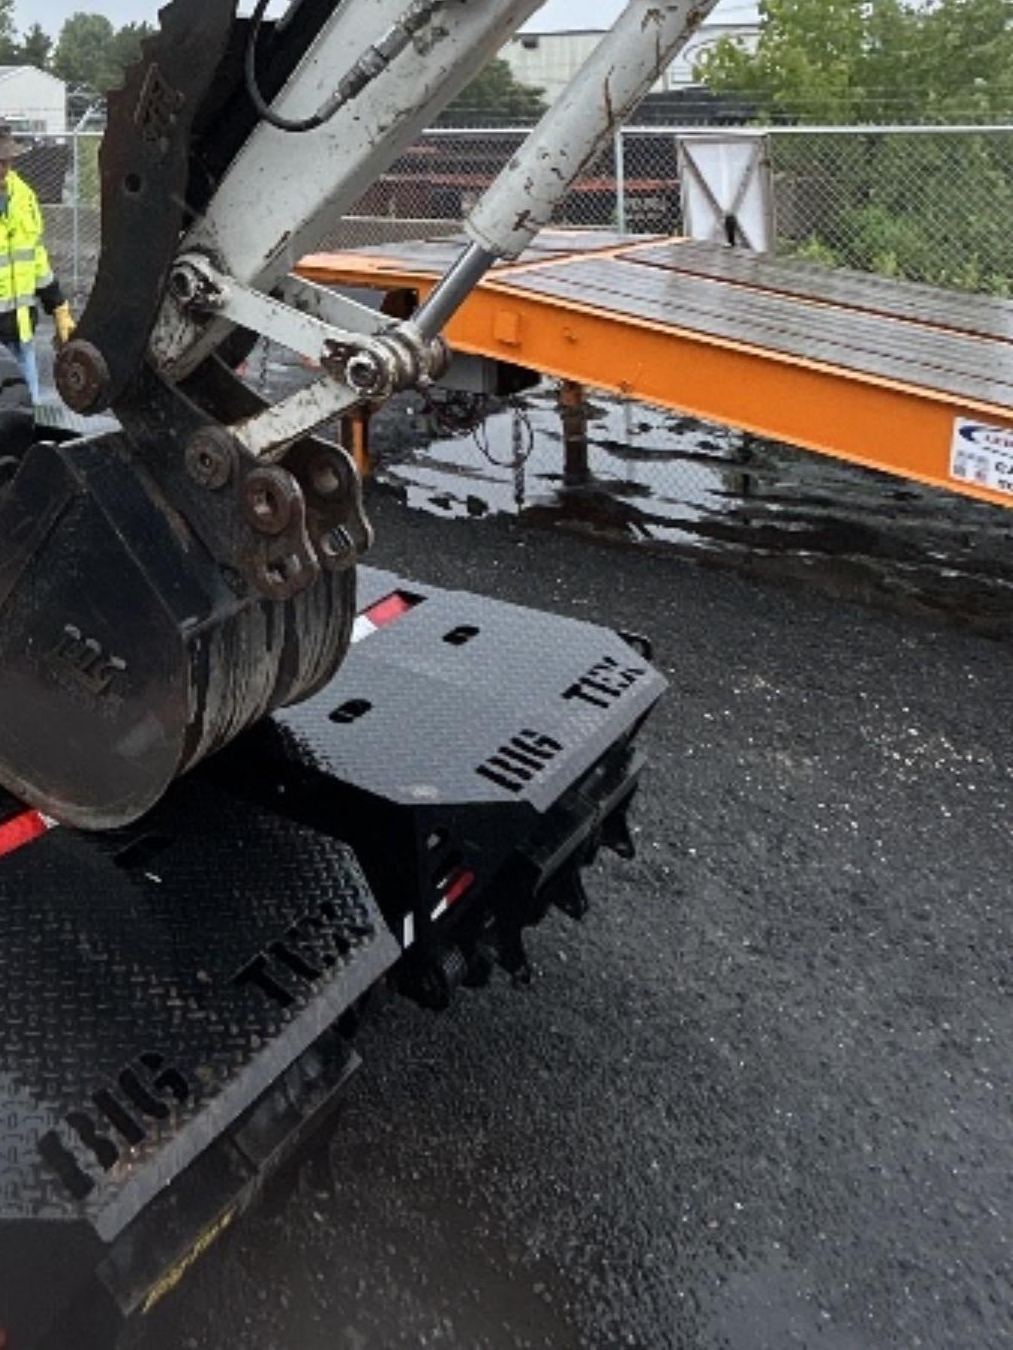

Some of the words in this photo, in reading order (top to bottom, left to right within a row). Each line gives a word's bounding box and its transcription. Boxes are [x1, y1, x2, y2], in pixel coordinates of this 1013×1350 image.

[476, 728, 564, 792] BIG
[561, 656, 645, 708] TEX
[39, 1052, 189, 1200] BIG
[235, 901, 375, 1007] TEX
